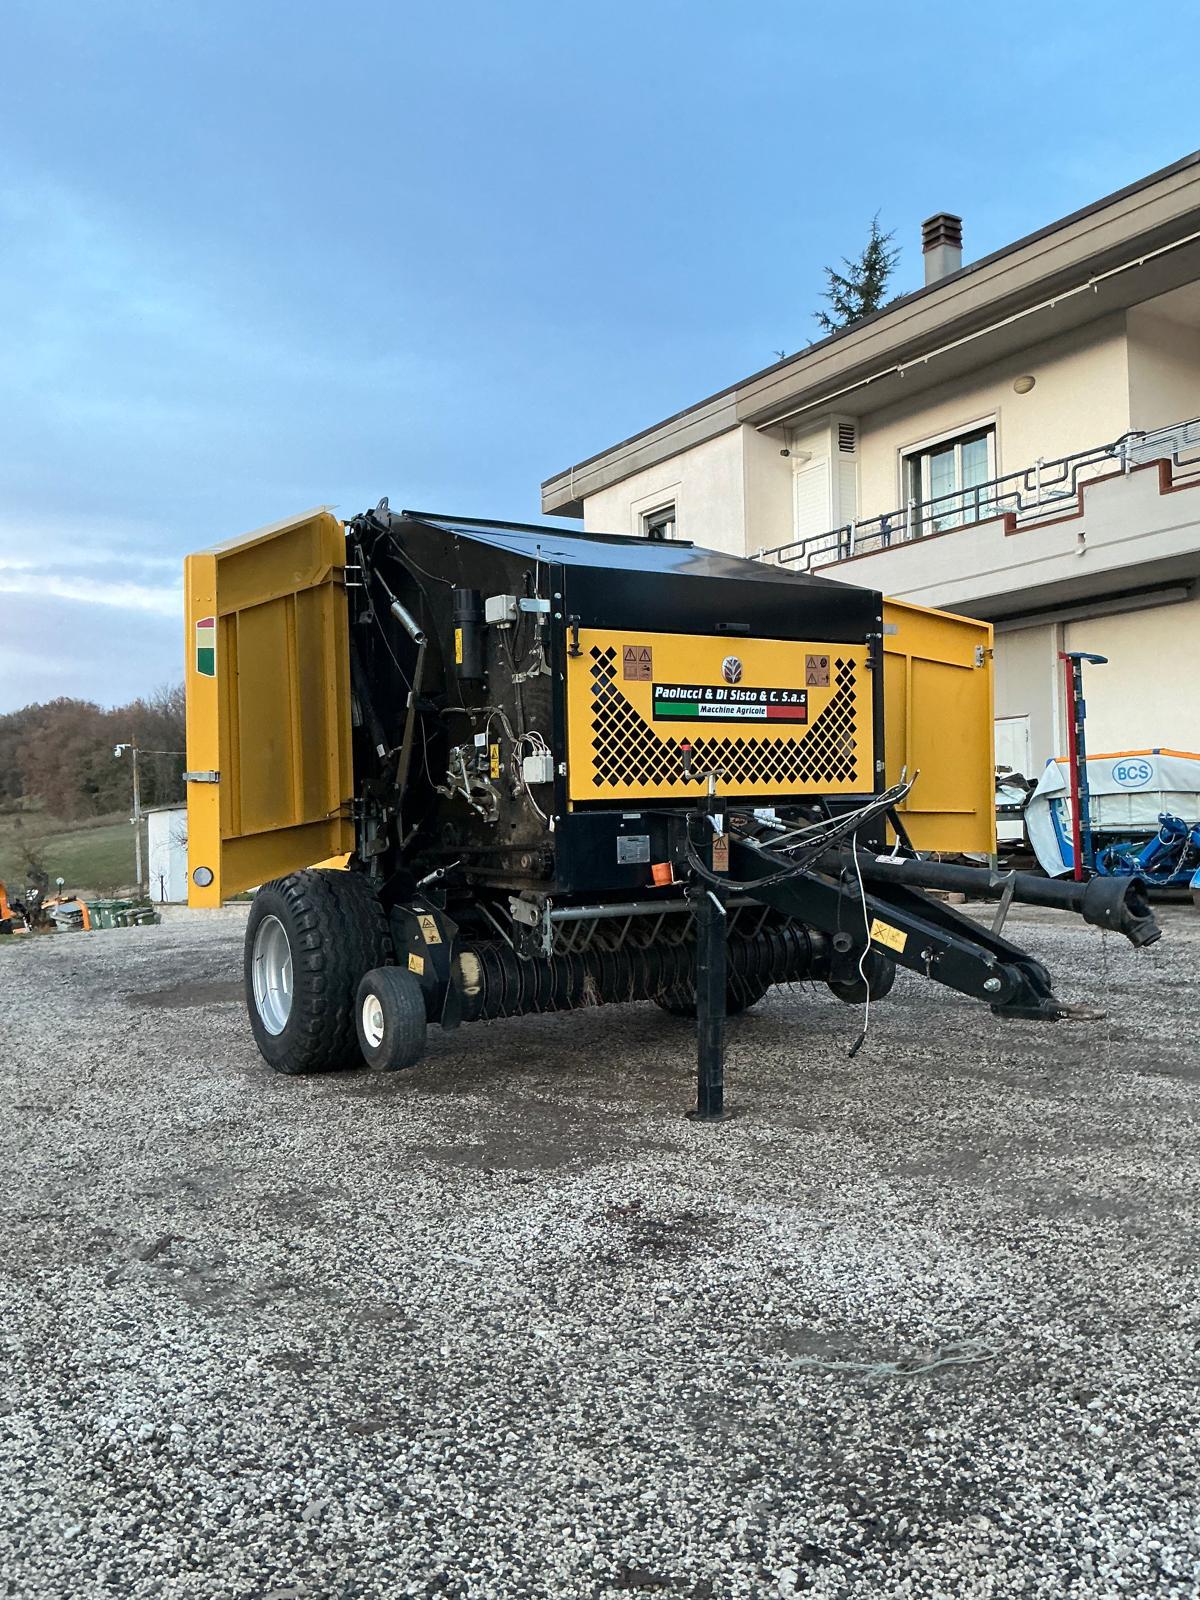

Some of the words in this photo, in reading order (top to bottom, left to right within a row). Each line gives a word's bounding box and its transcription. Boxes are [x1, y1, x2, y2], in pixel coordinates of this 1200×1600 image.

[655, 686, 702, 699] Paolucci
[705, 688, 713, 700] &
[716, 689, 728, 700] Di
[729, 690, 757, 701] Sisto
[759, 690, 767, 702] &
[769, 691, 779, 702] C.
[782, 691, 806, 703] S.a.s
[700, 705, 735, 714] Macchine
[736, 707, 766, 716] Agricole
[1117, 765, 1149, 780] BCS
